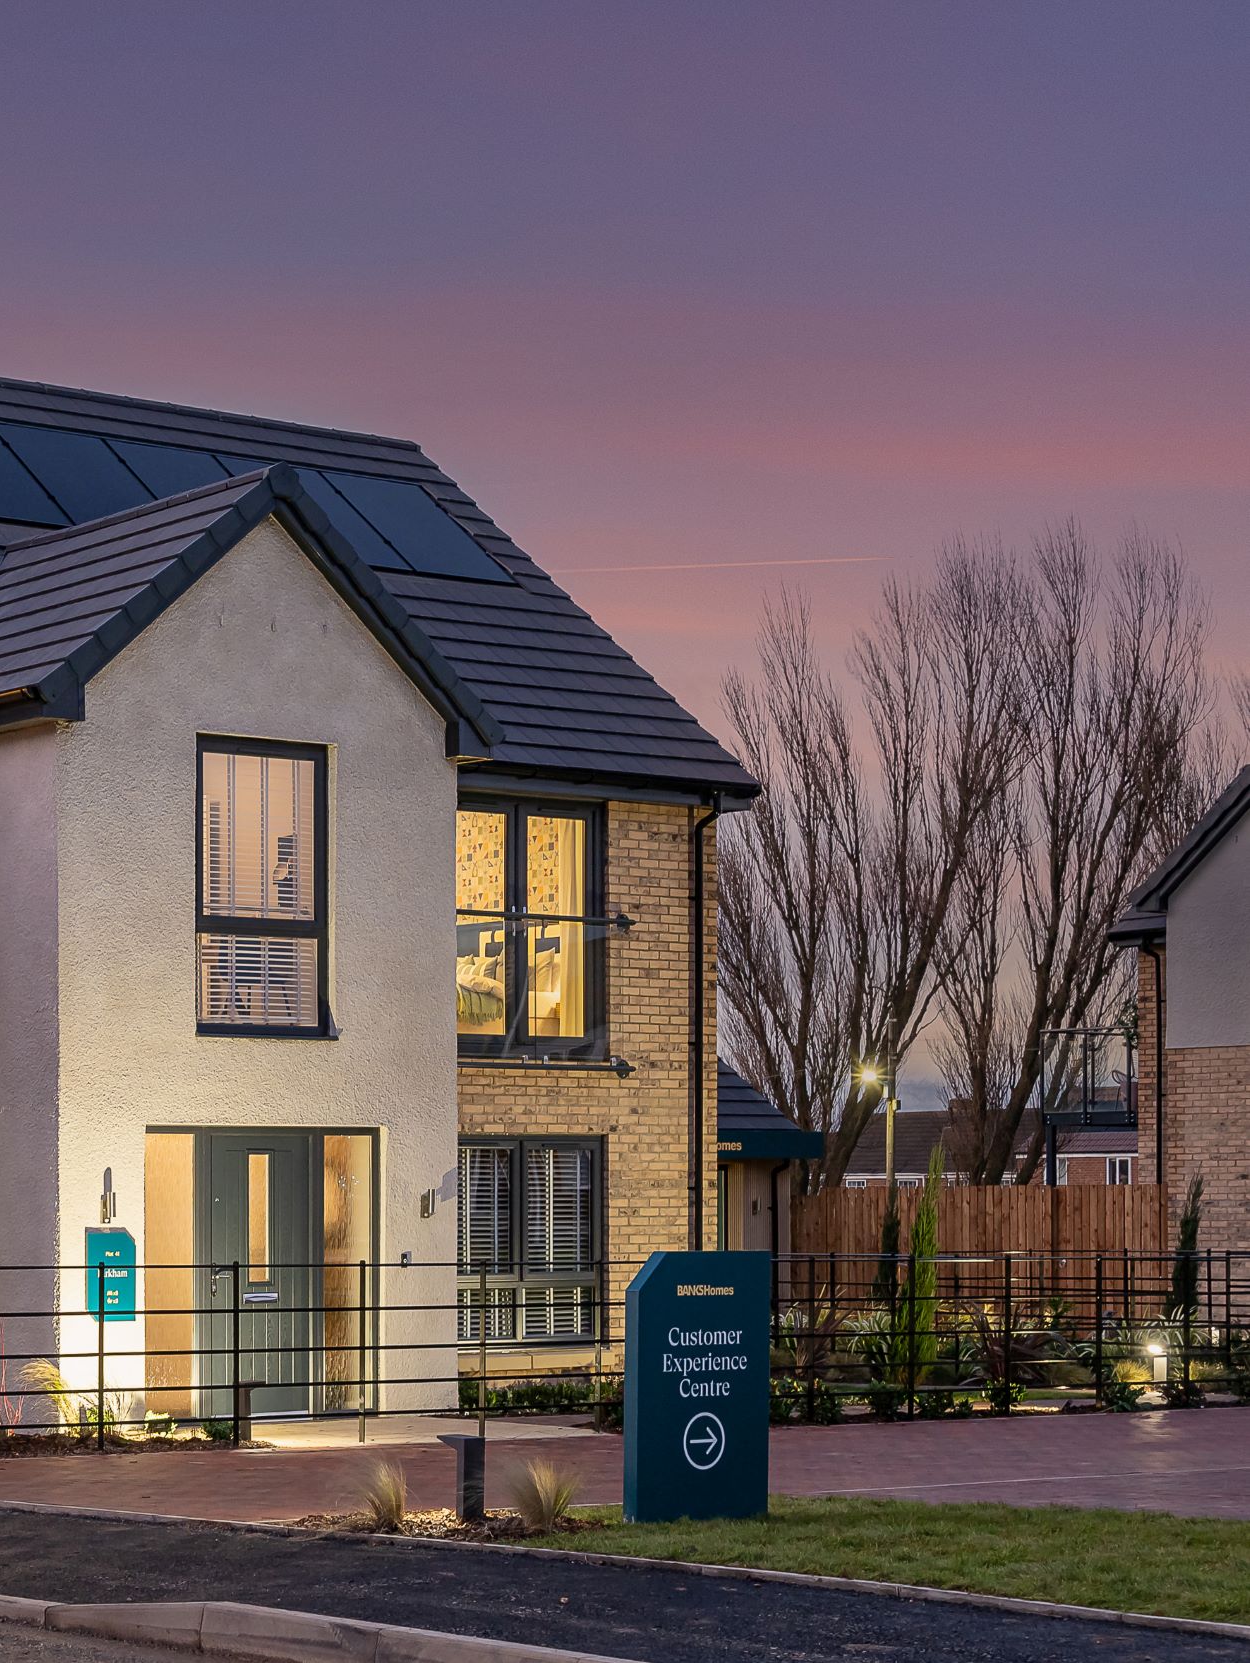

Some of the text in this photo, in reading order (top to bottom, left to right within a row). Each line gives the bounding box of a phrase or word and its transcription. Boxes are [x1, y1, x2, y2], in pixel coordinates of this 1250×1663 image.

[668, 1326, 743, 1347] Customer
[662, 1352, 748, 1377] Experience
[679, 1378, 731, 1398] Centre
